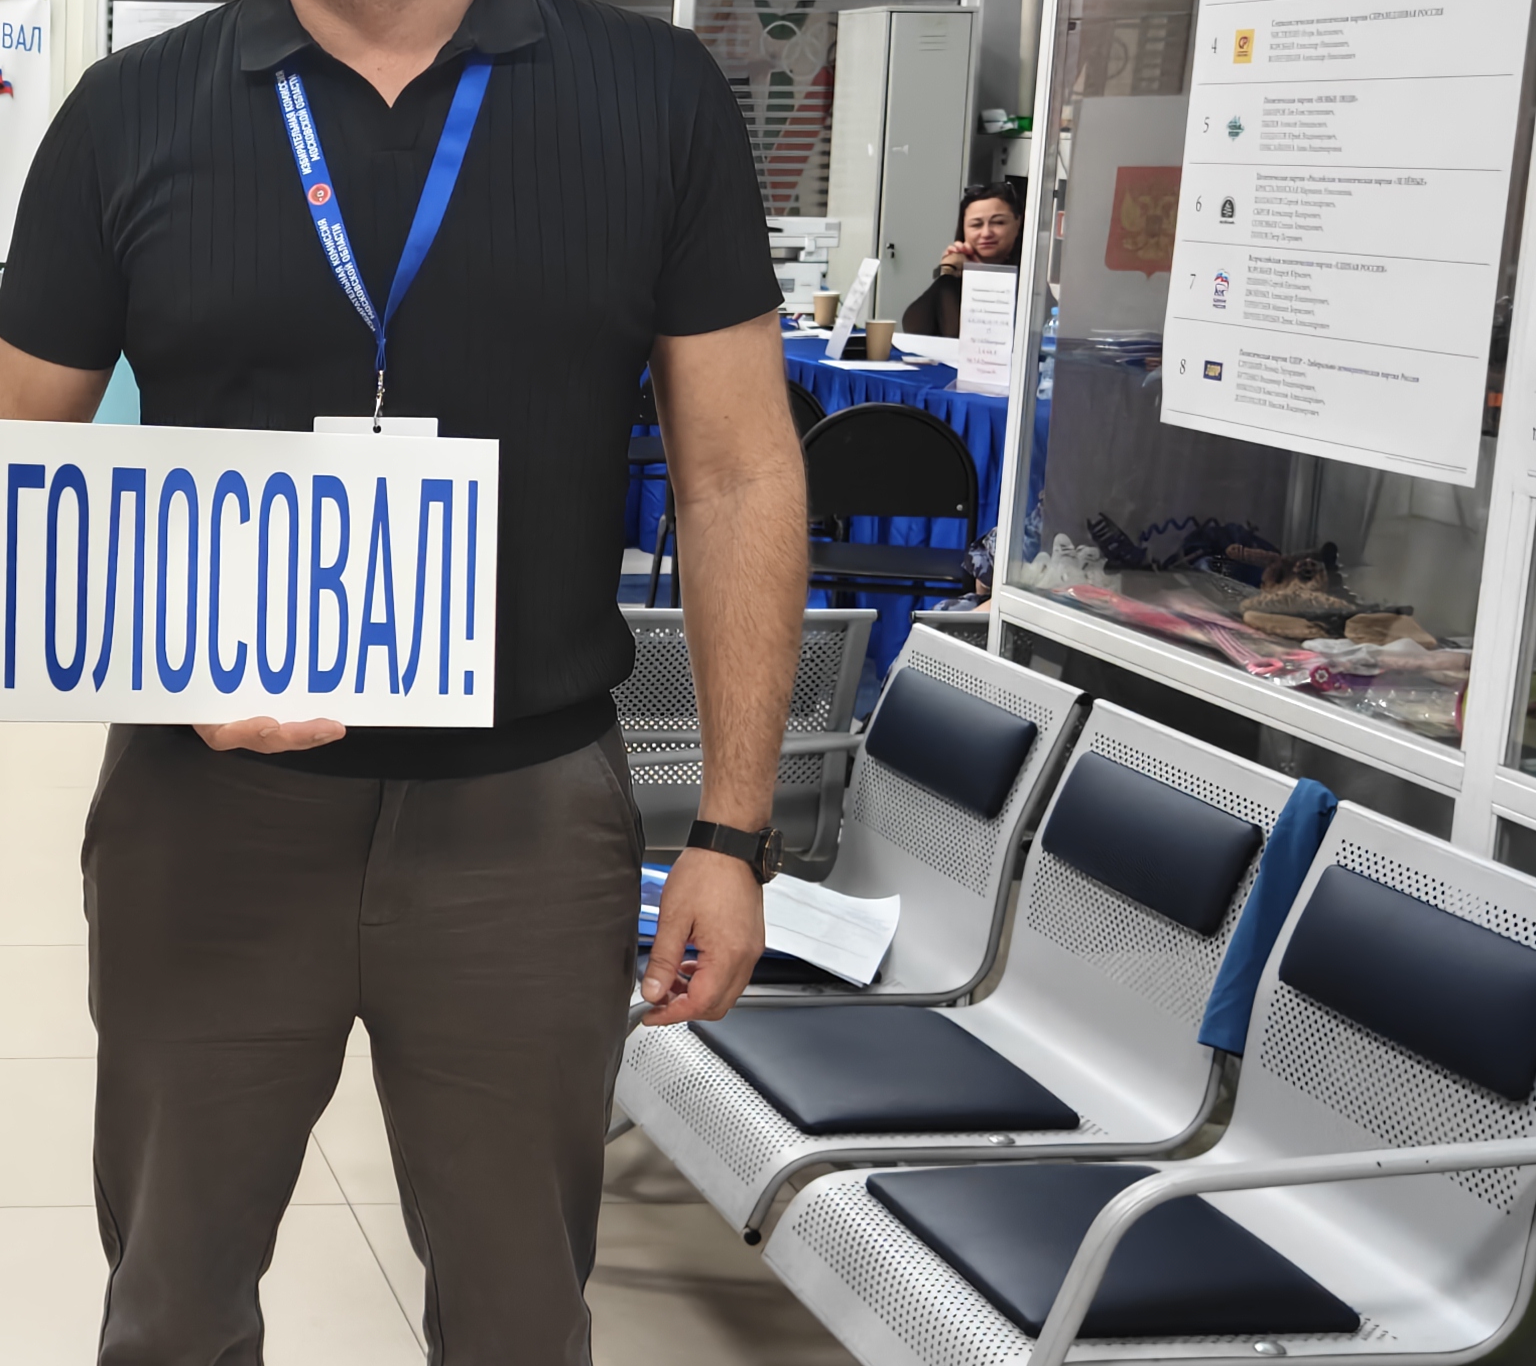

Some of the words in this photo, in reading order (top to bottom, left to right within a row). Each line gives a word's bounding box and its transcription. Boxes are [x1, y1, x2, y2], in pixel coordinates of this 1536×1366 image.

[1211, 37, 1217, 55] 4
[287, 73, 306, 109] ОБЛАСТИ
[296, 108, 321, 162] МОСКОВСКОЙ
[1203, 115, 1210, 133] 5
[285, 111, 313, 176] ИЗБИРАТЕЛЬНАЯ
[1195, 195, 1202, 212] 6
[317, 218, 342, 267] КОМИССИЯ
[331, 222, 352, 263] ОБЛАСТИ
[335, 264, 376, 332] ИЗБИРАТЕЛЬНАЯ
[343, 261, 376, 319] МОСКОВСКОЙ
[1189, 273, 1197, 290] 7
[1179, 358, 1186, 375] 8
